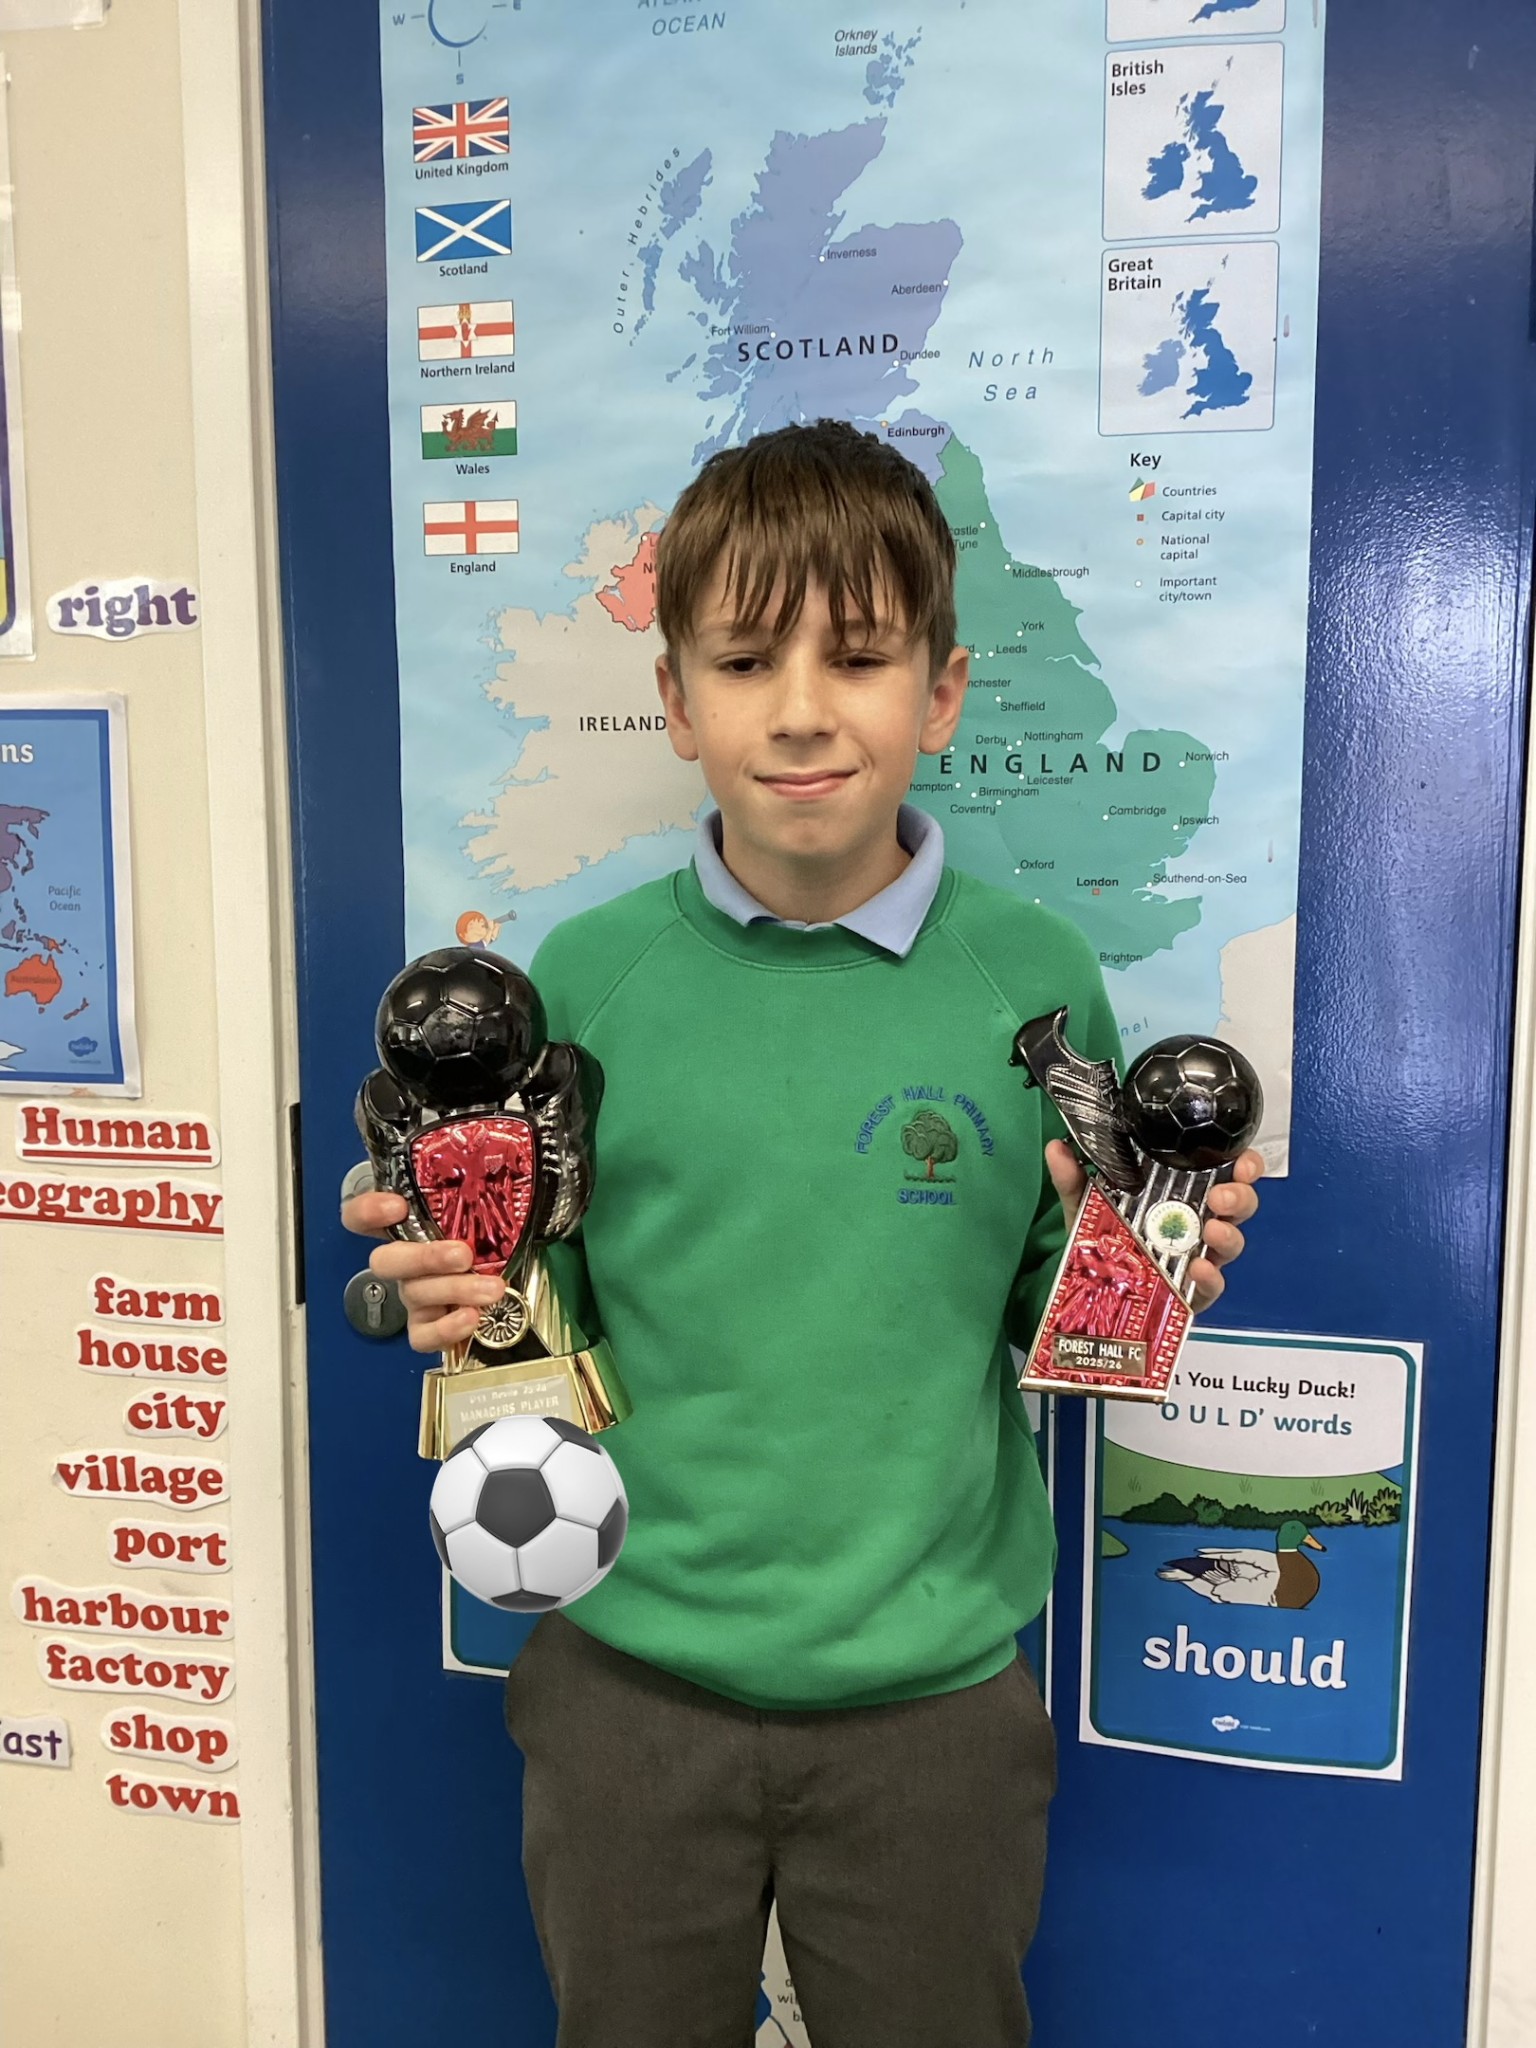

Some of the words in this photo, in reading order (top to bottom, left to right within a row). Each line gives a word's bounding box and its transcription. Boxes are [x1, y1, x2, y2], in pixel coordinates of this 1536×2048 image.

[392, 13, 405, 26] W
[652, 11, 726, 36] OCEAN
[834, 28, 878, 45] Orkney
[835, 42, 878, 57] Islands
[1112, 59, 1164, 77] British
[456, 73, 464, 85] S
[1111, 81, 1146, 96] Isles
[415, 161, 453, 180] United
[456, 161, 509, 178] Kingdom
[613, 270, 630, 334] Outer
[628, 147, 680, 245] Hebrides
[827, 248, 877, 260] Inverness
[439, 261, 488, 277] Scotland
[1108, 257, 1153, 273] Great
[891, 283, 942, 295] Aberdeen
[1108, 274, 1161, 291] Britain
[711, 325, 731, 337] Fort
[733, 323, 770, 335] William
[738, 333, 898, 362] SCOTLAND
[900, 348, 940, 361] Dundee
[968, 347, 1054, 368] North
[420, 363, 472, 378] Northern
[475, 361, 515, 375] Ireland
[983, 384, 1037, 402] Sea
[887, 425, 945, 439] Edinburgh
[1130, 452, 1161, 470] Key
[456, 463, 490, 475] Wales
[1162, 485, 1217, 497] Countries
[1161, 510, 1202, 523] Capital
[1205, 509, 1226, 522] city
[1161, 533, 1210, 545] National
[1160, 549, 1198, 562] capital
[450, 560, 496, 576] England
[1012, 566, 1090, 579] Middlesbrough
[1159, 577, 1217, 589] Important
[1159, 591, 1212, 604] city/town
[58, 583, 197, 635] right
[1021, 621, 1045, 631] York
[996, 643, 1028, 654] Leeds
[967, 678, 1011, 688] nchester
[1000, 701, 1046, 712] Sheffield
[579, 715, 667, 732] IRELAND
[975, 735, 1007, 745] Derby
[1024, 731, 1083, 742] Nottingham
[940, 752, 1161, 775] ENGLAND
[1185, 751, 1229, 762] Norwich
[1027, 775, 1073, 785] Leicester
[909, 783, 953, 793] hampton
[979, 787, 1039, 798] Birmingham
[950, 804, 996, 816] Coventry
[1108, 805, 1166, 817] Cambridge
[1179, 815, 1219, 828] Ipswich
[1020, 859, 1055, 870] Oxford
[1076, 877, 1119, 887] London
[1153, 873, 1247, 884] Southend-on-Sea
[48, 885, 82, 899] Pacific
[49, 900, 81, 912] Ocean
[1099, 952, 1143, 964] Brighton
[21, 1106, 211, 1150] Human
[855, 1095, 897, 1154] FOREST
[903, 1085, 945, 1102] HALL
[953, 1093, 995, 1157] PRIMARY
[898, 1189, 957, 1205] SCHOOL
[0, 1181, 223, 1229] ography
[94, 1277, 222, 1323] farm
[77, 1329, 227, 1376] house
[1058, 1339, 1094, 1356] FOREST
[1099, 1343, 1124, 1359] HALL
[1188, 1371, 1224, 1389] You
[1232, 1375, 1290, 1399] Lucky
[1298, 1379, 1356, 1398] Duck!
[127, 1392, 226, 1438] city
[460, 1402, 516, 1422] MANAGERS
[520, 1395, 559, 1411] PLAYER
[1274, 1413, 1352, 1436] words
[56, 1455, 223, 1504] village
[113, 1525, 227, 1567] port
[21, 1586, 230, 1636] harbour
[1142, 1624, 1347, 1690] should
[46, 1645, 230, 1700] factory
[0, 1721, 62, 1760] ast
[110, 1714, 228, 1763] shop
[106, 1774, 240, 1818] town
